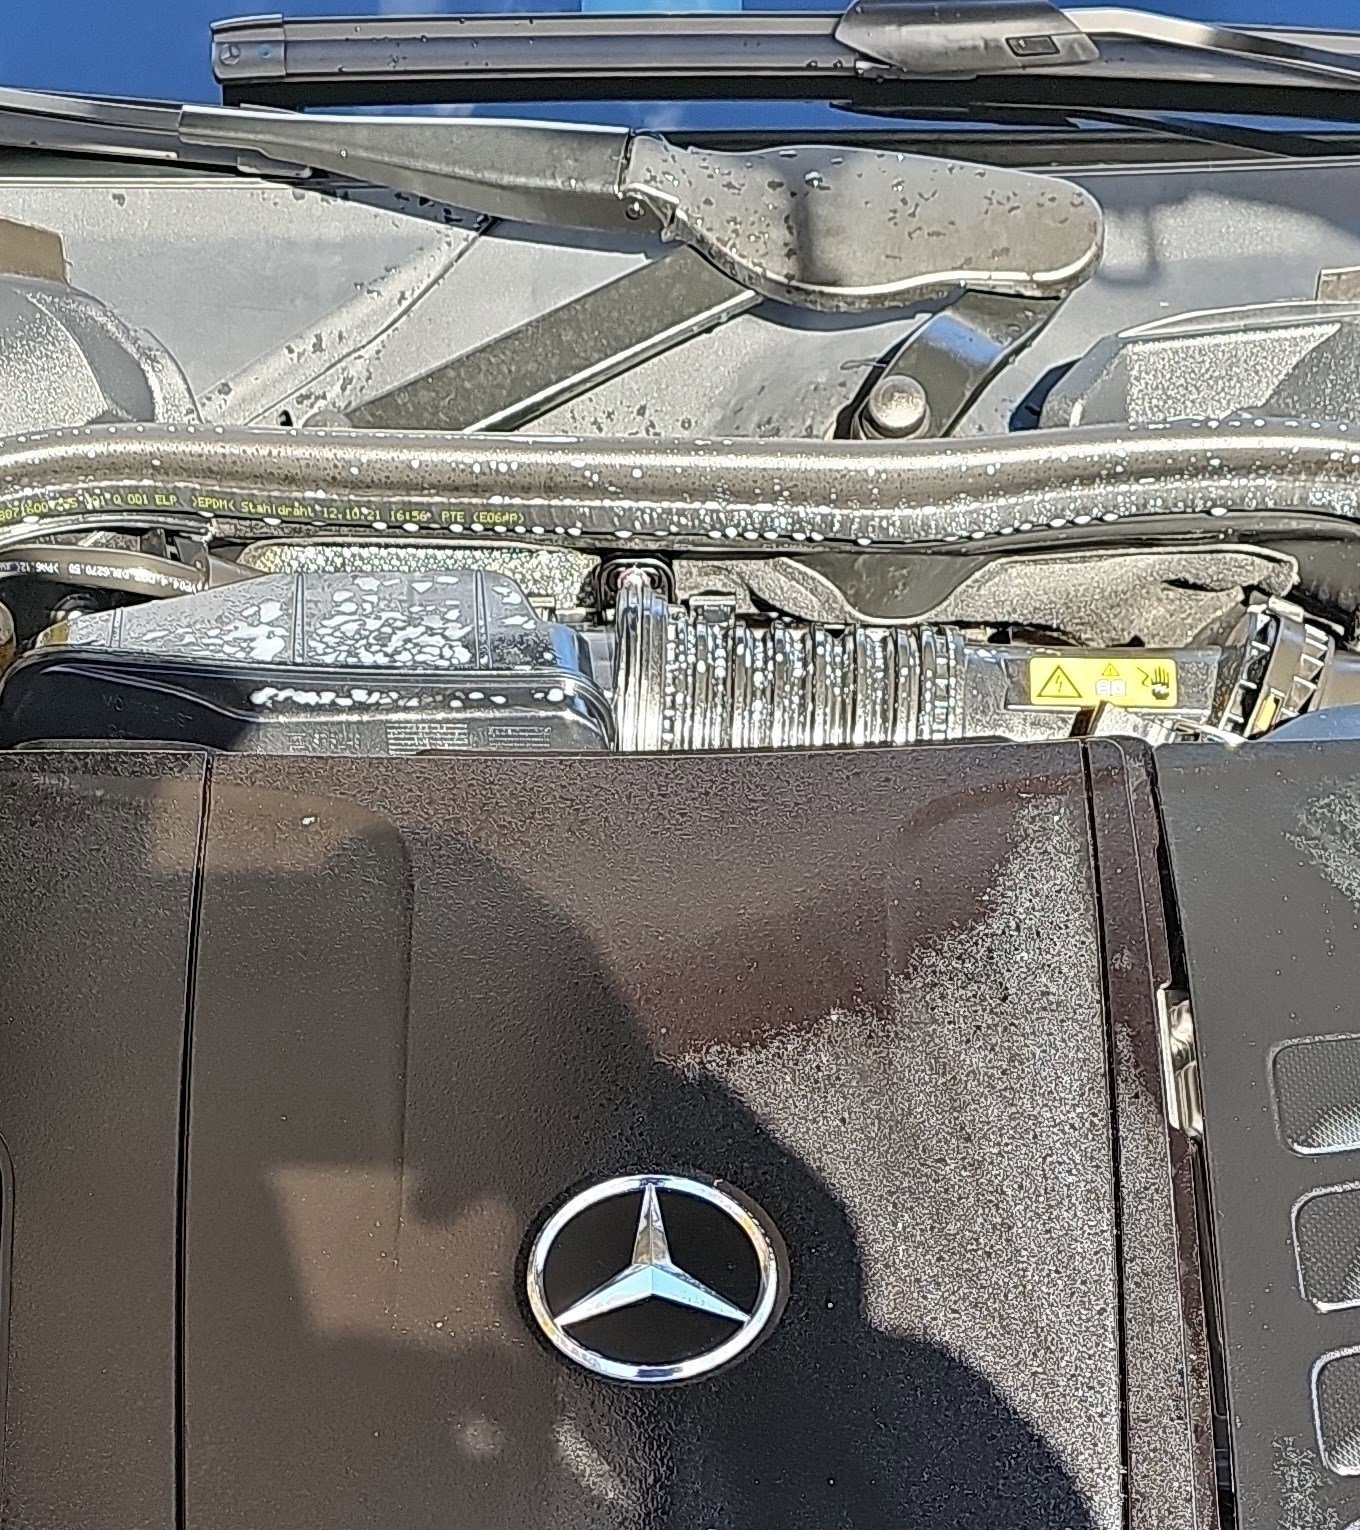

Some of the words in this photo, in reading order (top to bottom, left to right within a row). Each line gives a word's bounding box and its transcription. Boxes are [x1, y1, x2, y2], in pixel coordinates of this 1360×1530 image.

[127, 493, 148, 505] 001
[154, 493, 178, 506] ELP
[441, 511, 465, 522] PTE
